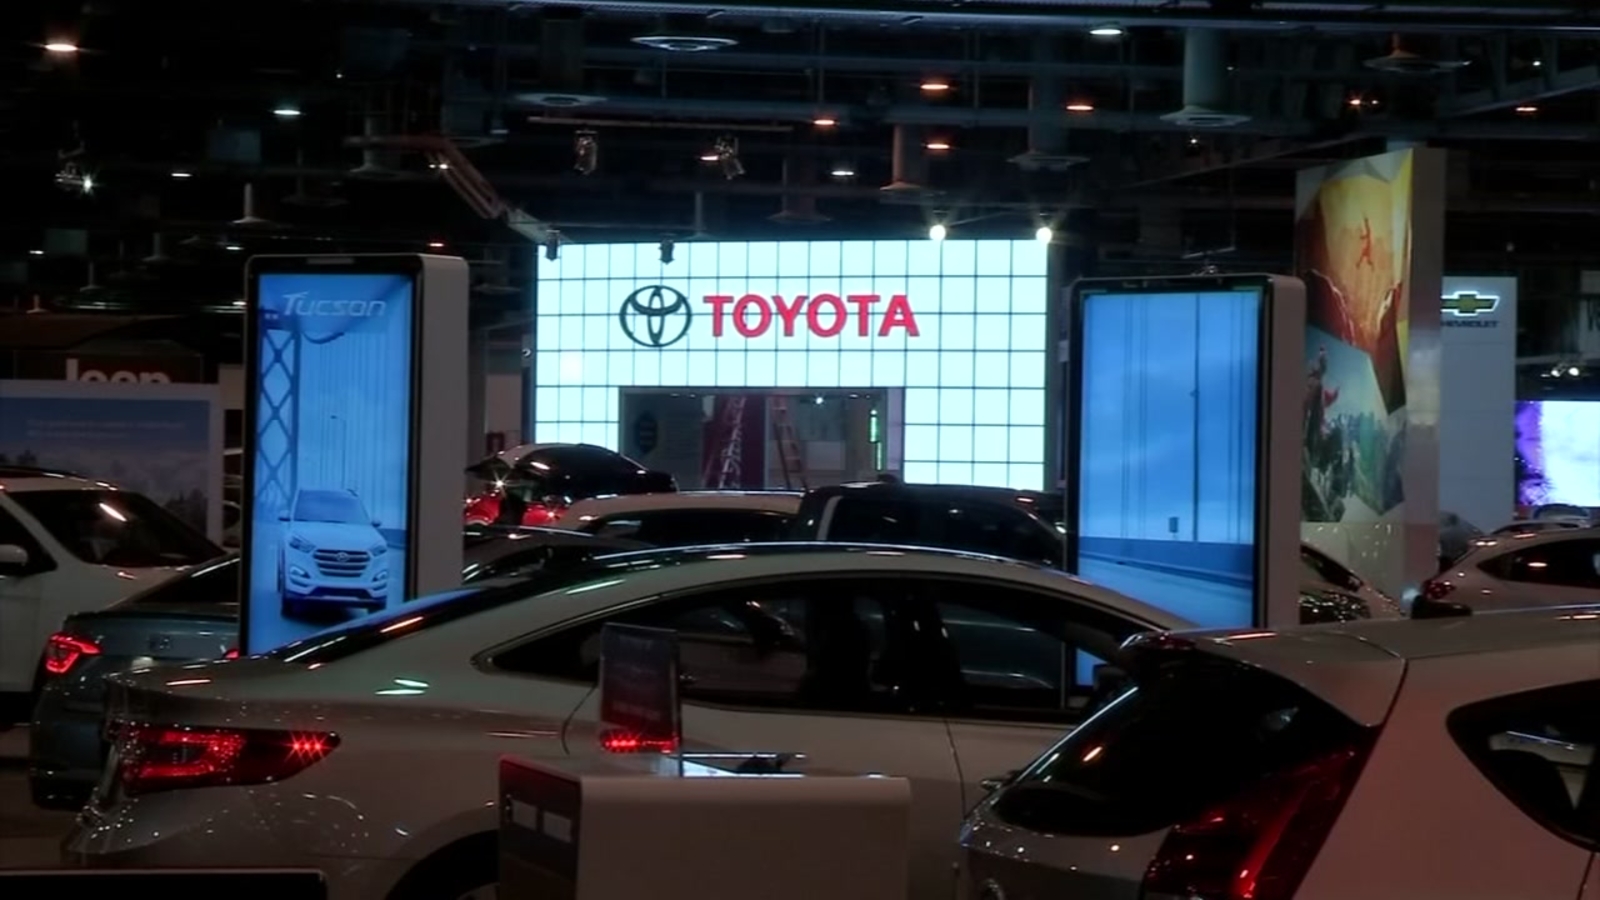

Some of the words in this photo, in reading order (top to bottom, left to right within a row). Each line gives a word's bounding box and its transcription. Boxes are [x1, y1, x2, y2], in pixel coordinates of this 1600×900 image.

[282, 291, 386, 317] Tucson
[703, 293, 920, 338] TOYOTA
[1440, 320, 1498, 328] HEVROLET
